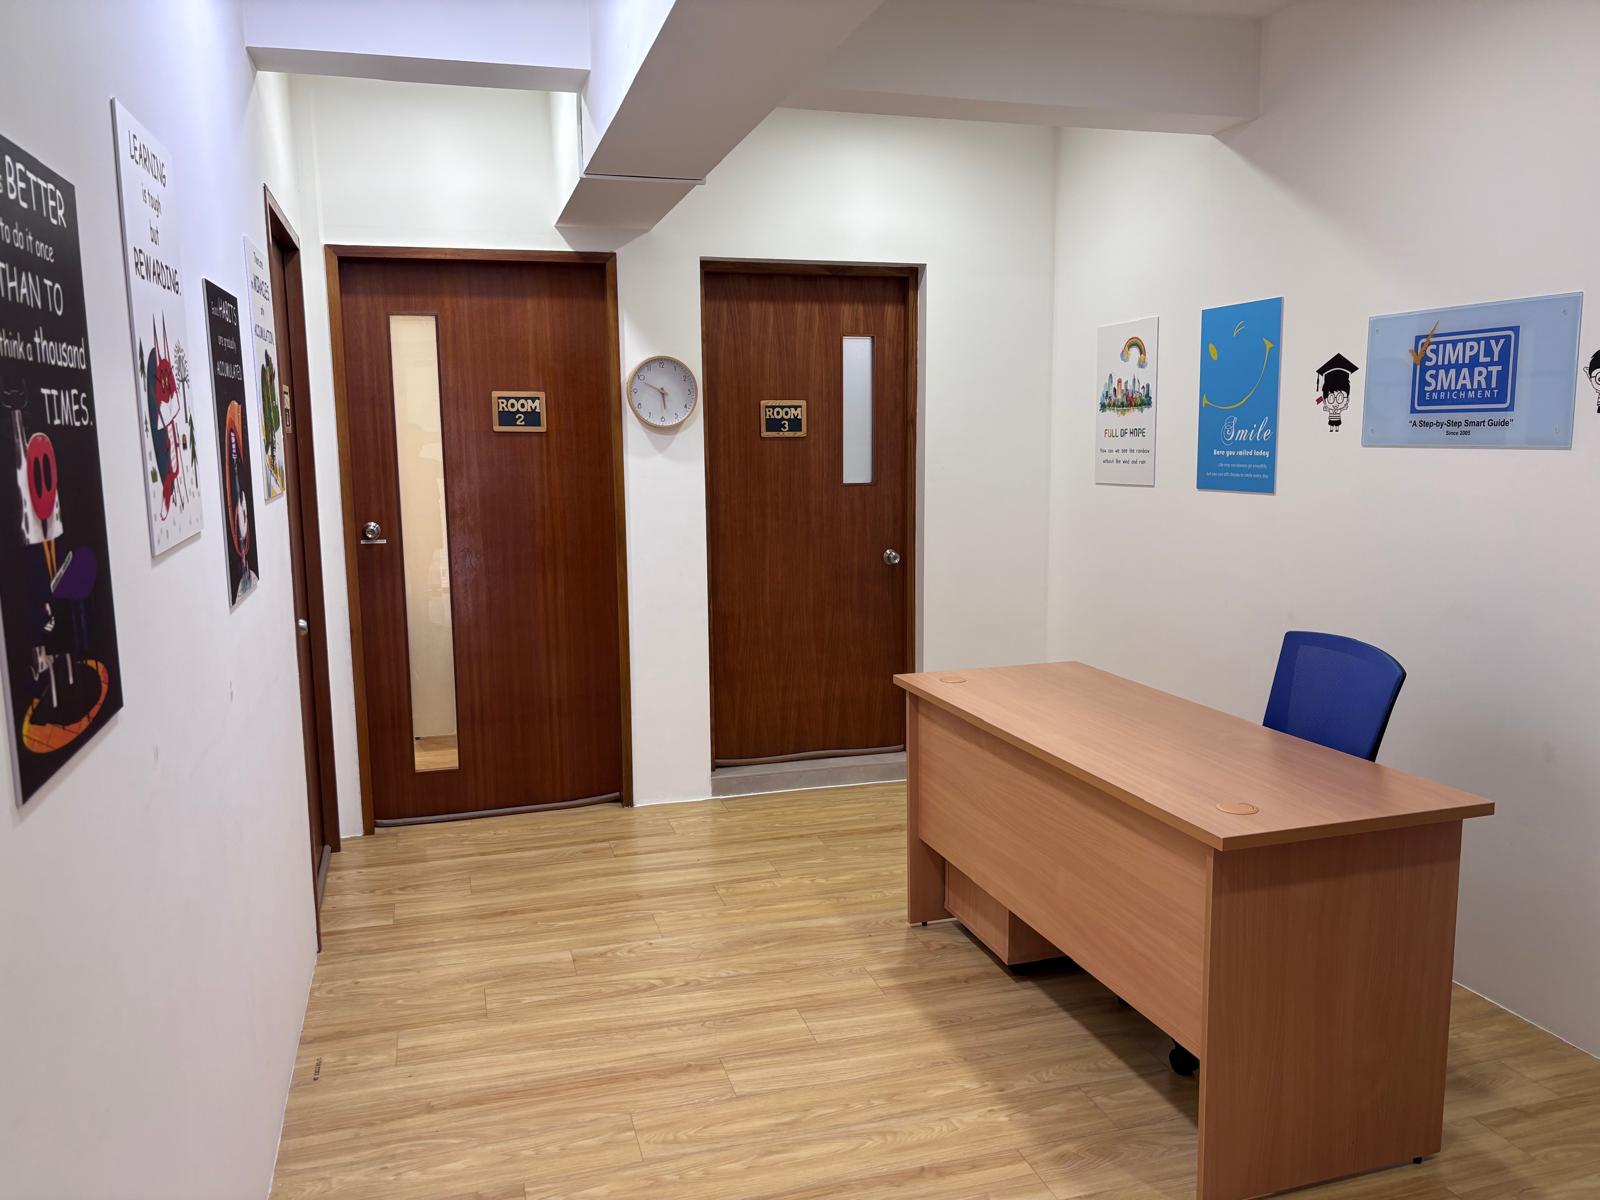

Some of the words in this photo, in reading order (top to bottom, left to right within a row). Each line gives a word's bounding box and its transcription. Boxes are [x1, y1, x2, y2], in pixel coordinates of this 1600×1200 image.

[128, 130, 167, 189] LEARNING
[5, 154, 67, 229] BETTER
[12, 221, 24, 250] do
[25, 228, 33, 254] it
[35, 240, 55, 263] once
[133, 247, 182, 297] REWARDING.
[0, 262, 41, 310] THAN
[43, 278, 64, 316] TO
[26, 343, 33, 361] a
[34, 326, 87, 369] thousand
[1425, 338, 1505, 367] SIMPLY
[1424, 365, 1502, 391] SMART
[40, 387, 93, 427] TIMES.
[498, 399, 541, 412] ROOM
[1425, 389, 1499, 400] ENRICHMENT
[515, 413, 525, 425] 2
[766, 407, 802, 419] ROOM
[780, 420, 789, 432] 3
[1418, 419, 1462, 430] Step-by-Step
[1464, 419, 1486, 428] Smart
[1104, 428, 1119, 438] FULL
[1120, 428, 1128, 438] OF
[1129, 427, 1147, 438] HOPE
[1221, 415, 1273, 446] Smile
[1253, 449, 1270, 458] today
